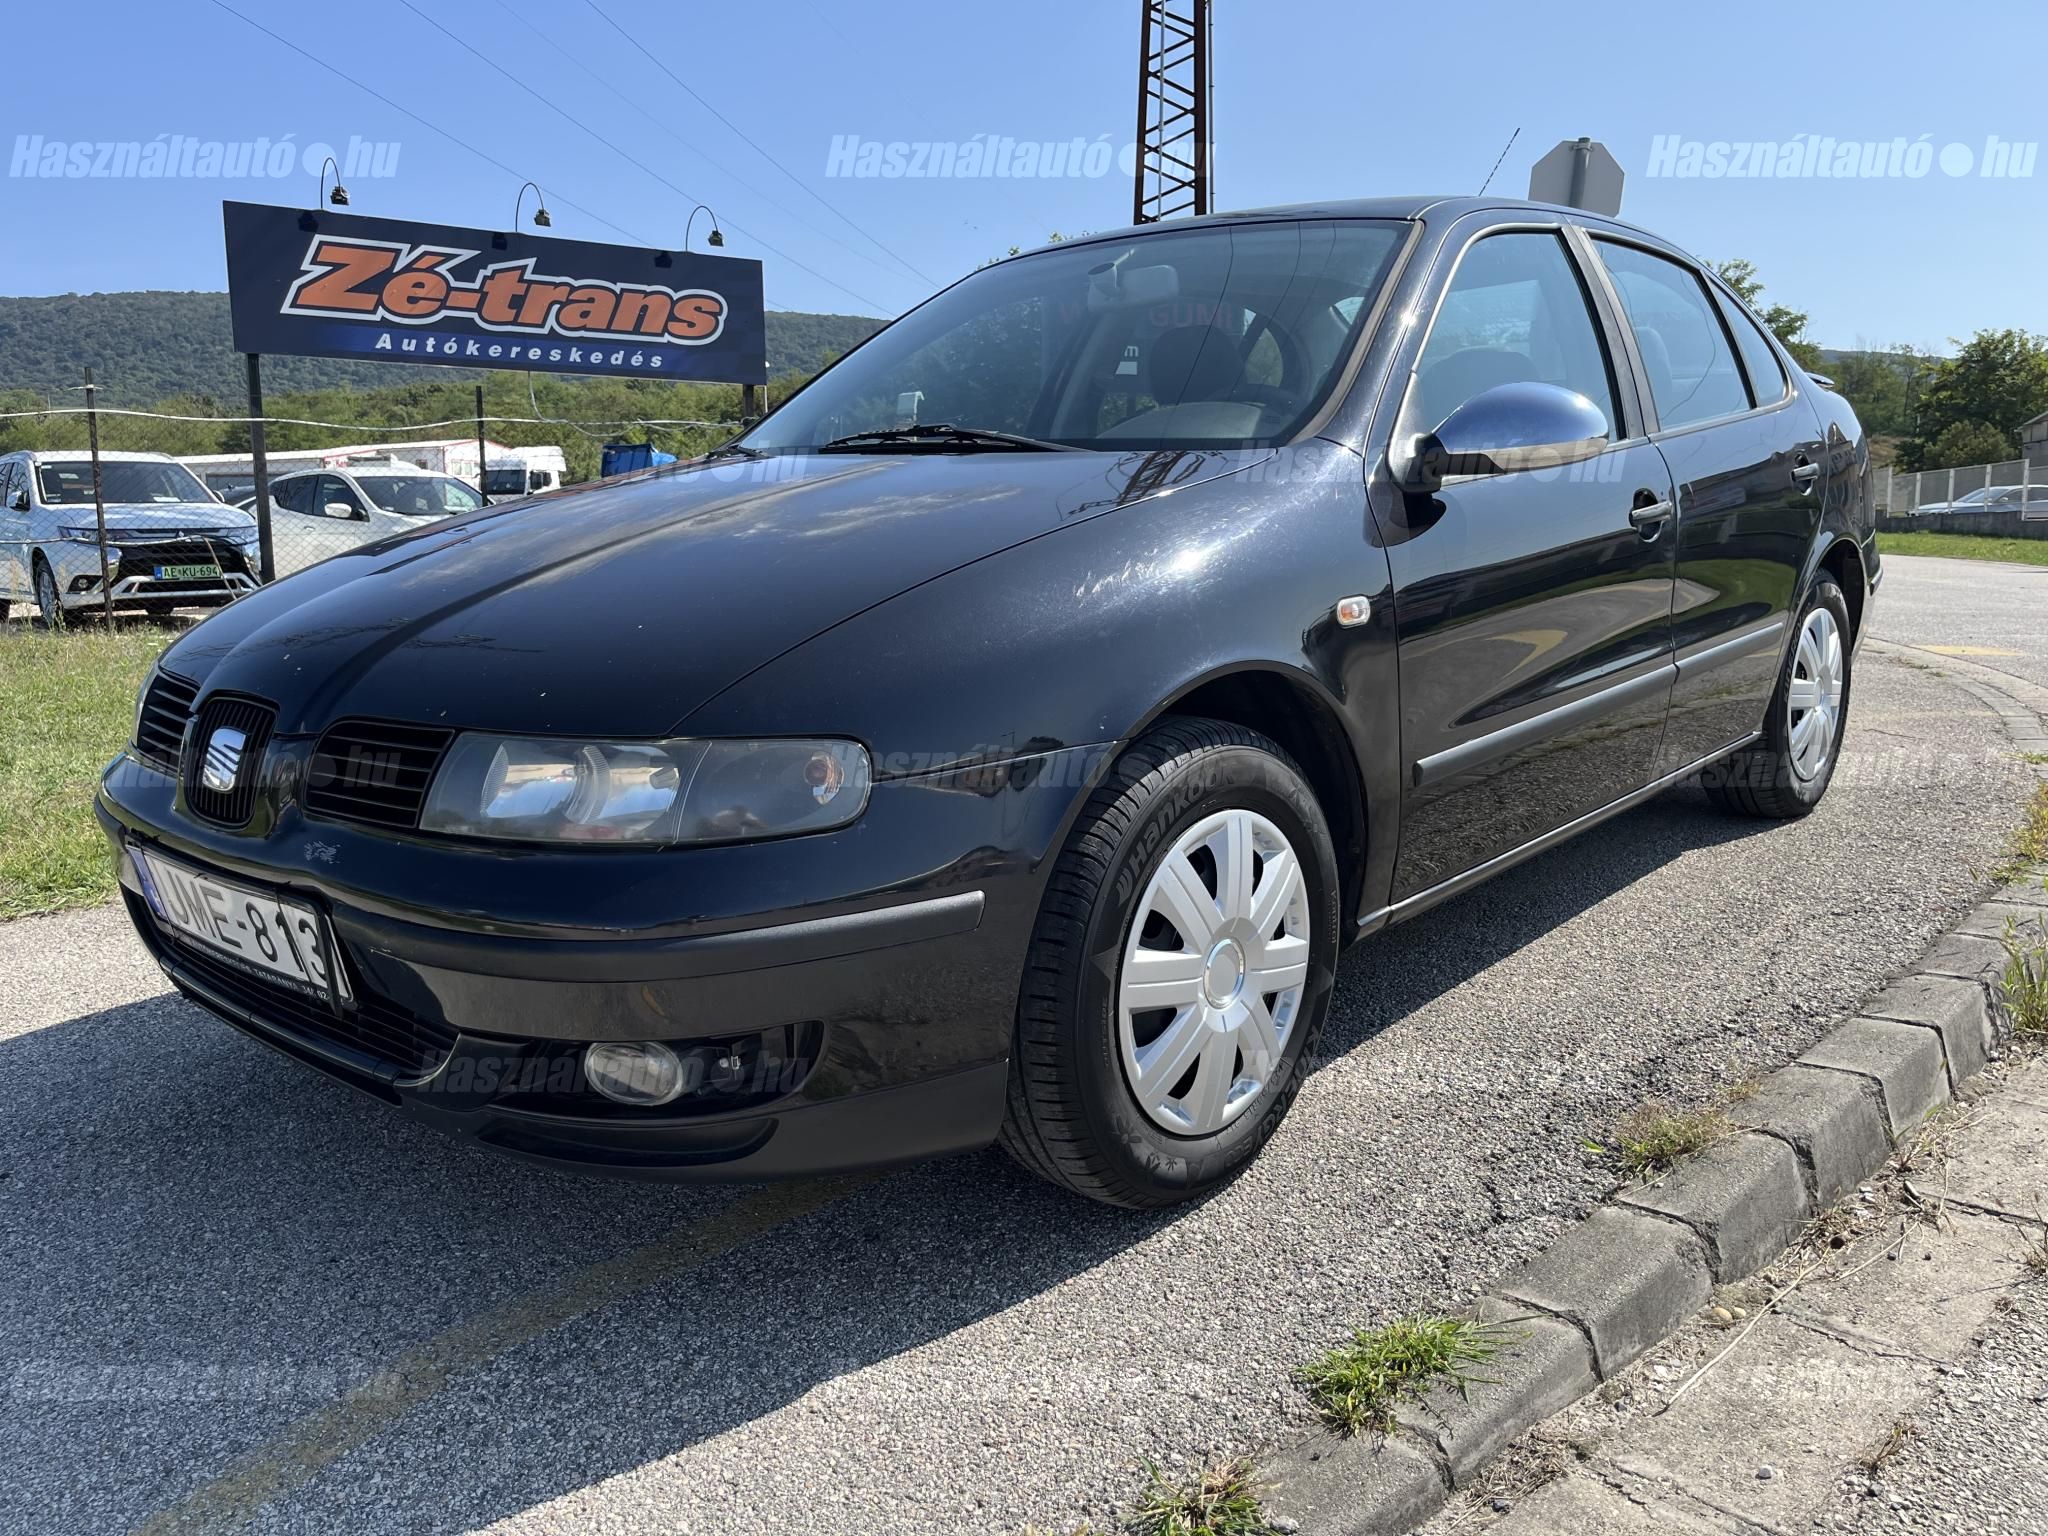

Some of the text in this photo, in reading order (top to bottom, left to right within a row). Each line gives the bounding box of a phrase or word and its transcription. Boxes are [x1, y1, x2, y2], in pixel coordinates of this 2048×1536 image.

[291, 240, 725, 341] Zé-trans
[375, 331, 664, 370] Autókereskedés
[164, 567, 177, 578] AE
[1131, 767, 1234, 874] Hankook
